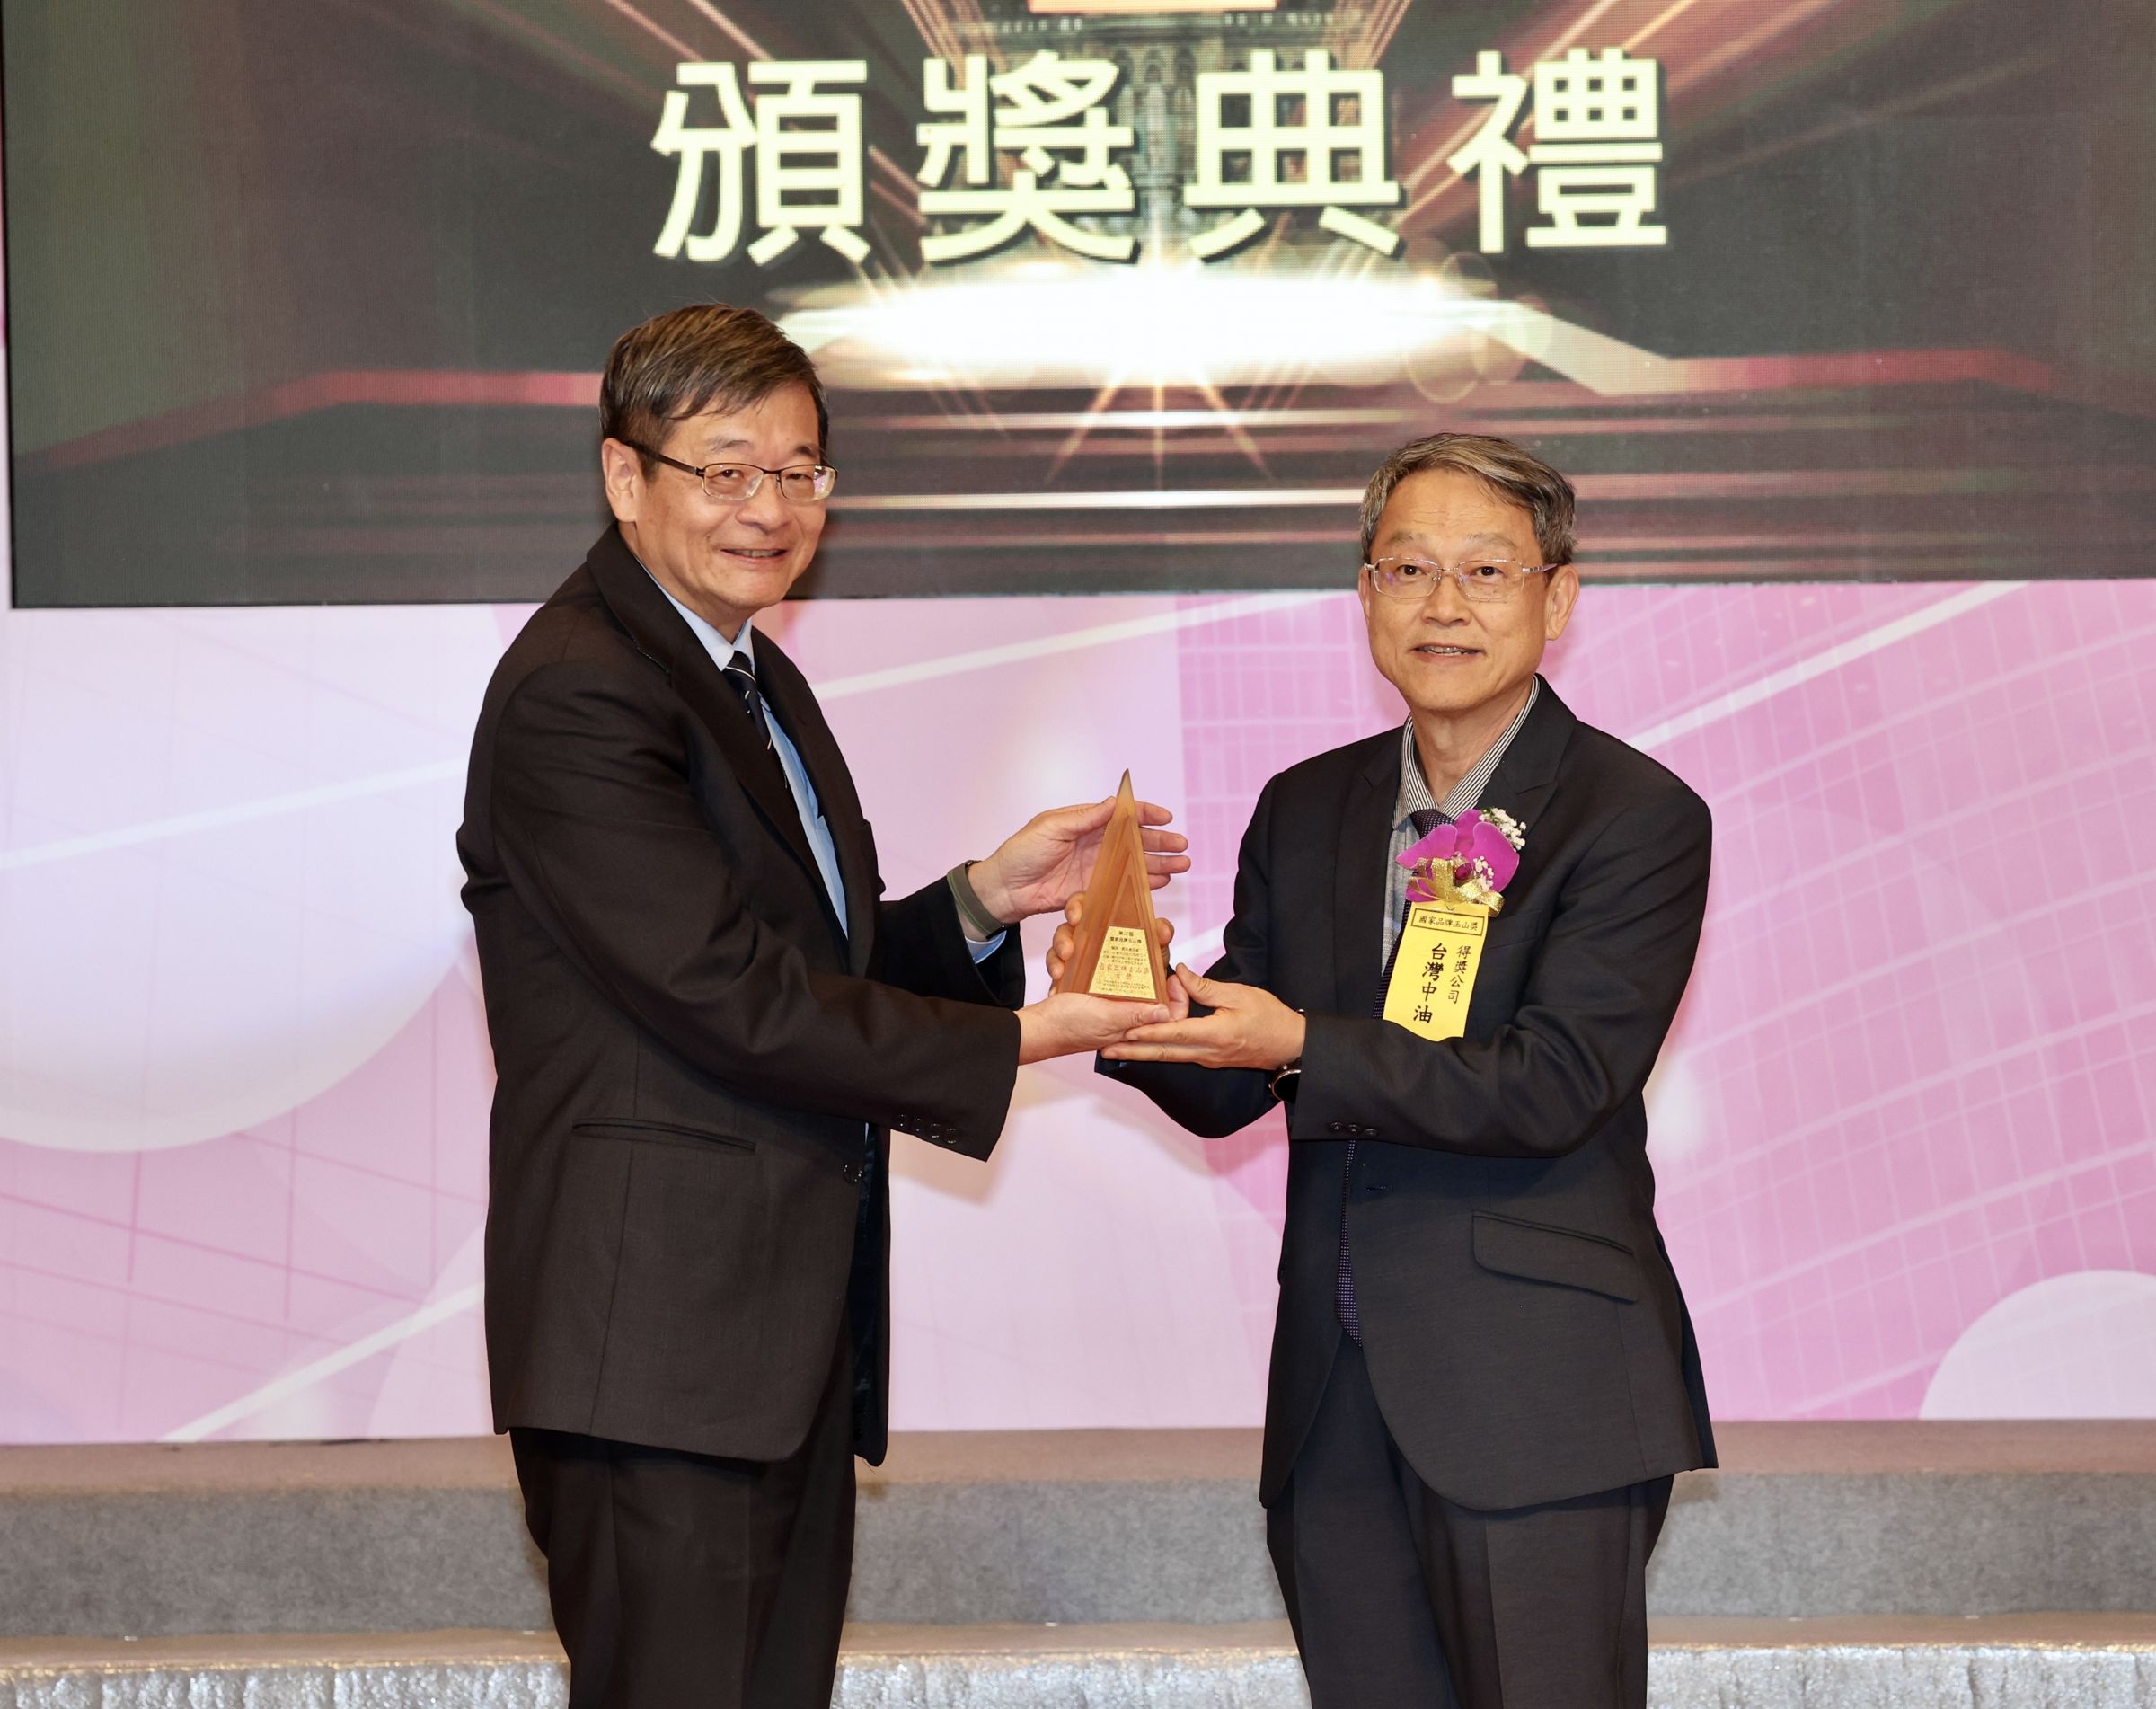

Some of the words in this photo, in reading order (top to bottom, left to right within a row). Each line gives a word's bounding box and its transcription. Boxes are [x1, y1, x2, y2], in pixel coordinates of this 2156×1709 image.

[652, 49, 1667, 267] 頒獎典禮
[1418, 915, 1479, 931] 國家品牌玉山獎
[1413, 943, 1447, 1024] 台灣中油
[1447, 944, 1472, 1005] 得獎公司
